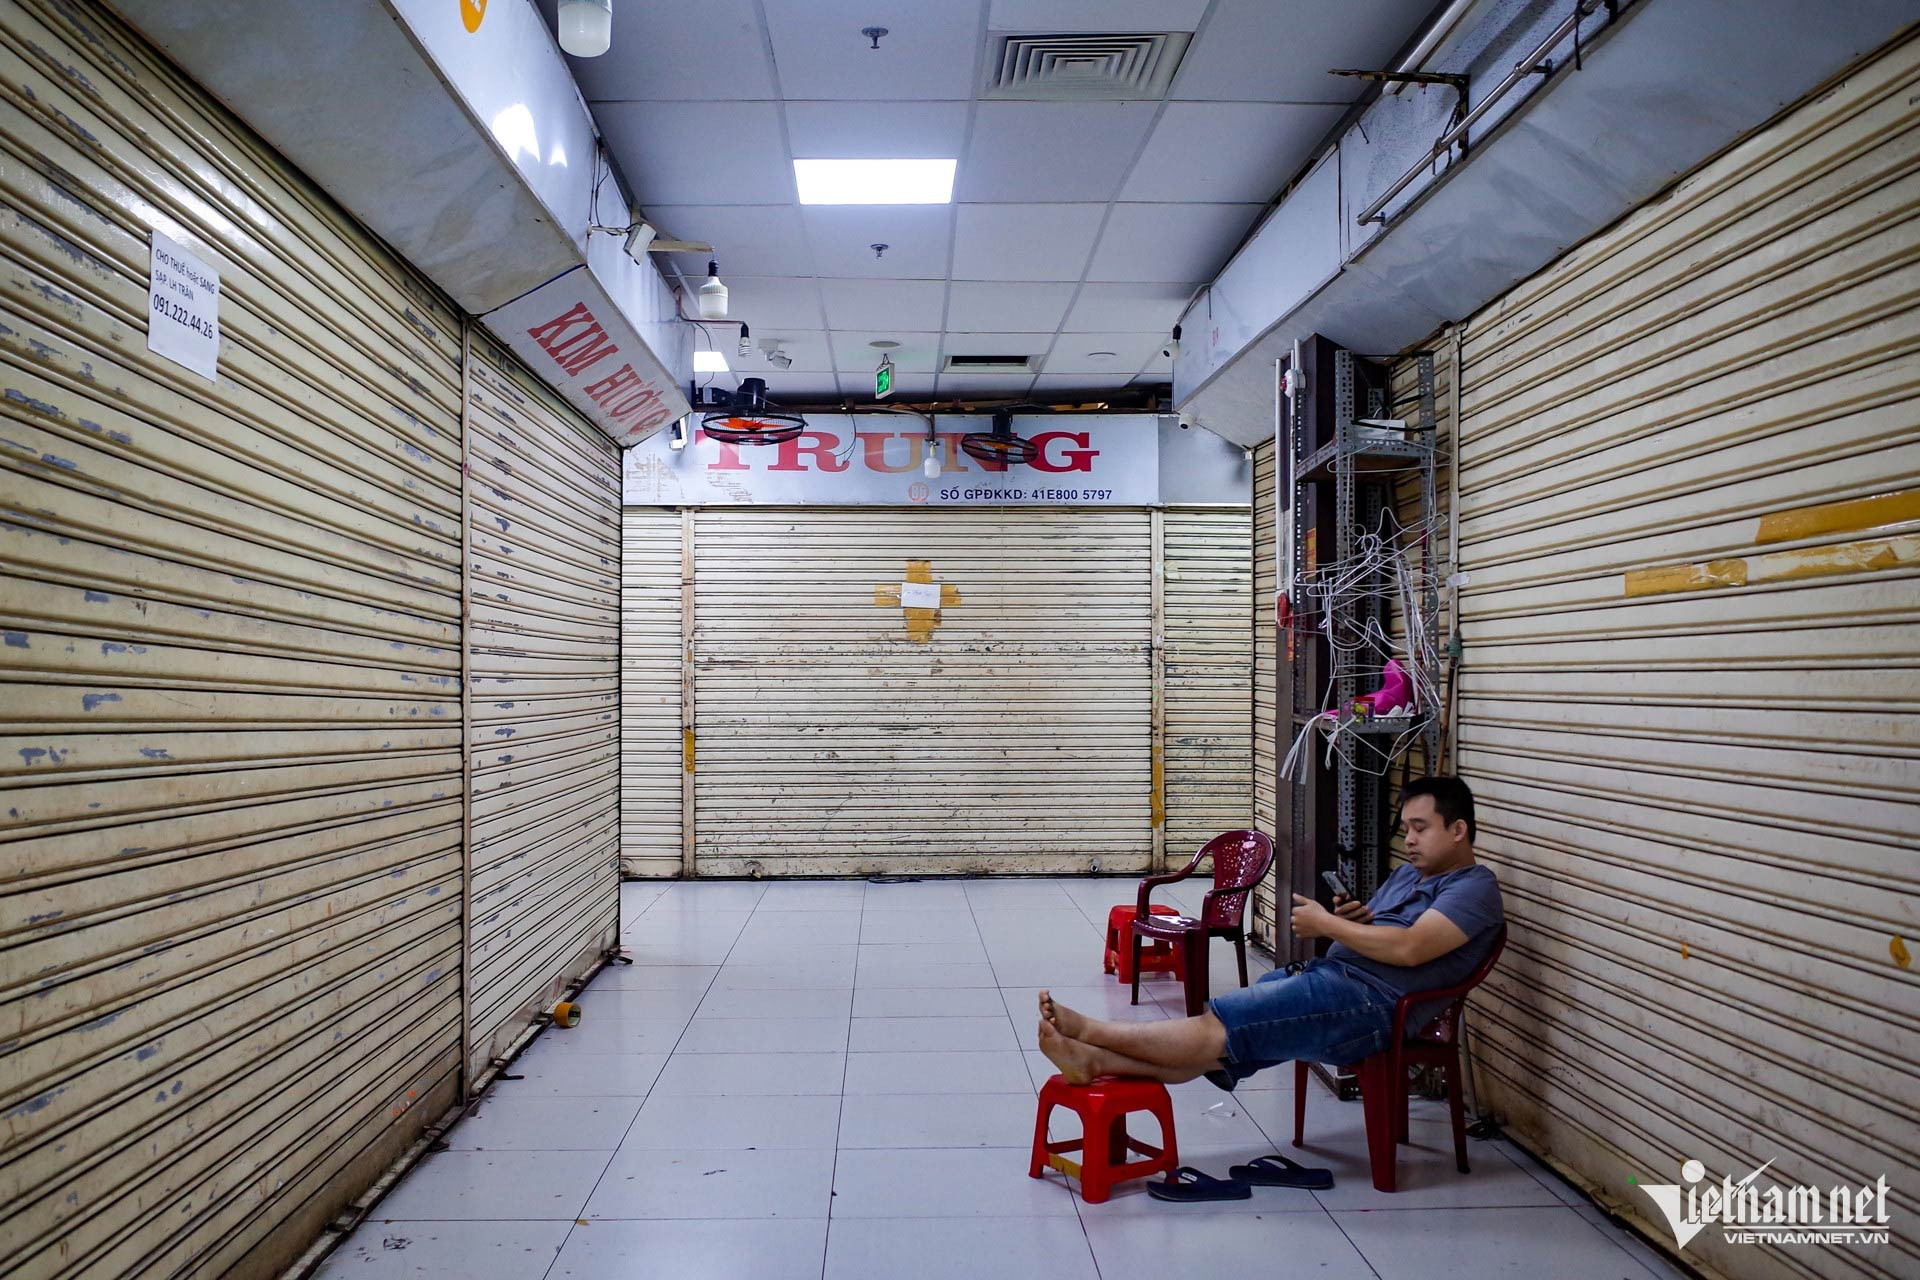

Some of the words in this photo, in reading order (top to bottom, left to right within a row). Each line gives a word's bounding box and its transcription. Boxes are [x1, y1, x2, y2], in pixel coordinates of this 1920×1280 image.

[155, 248, 169, 265] CHO
[199, 276, 215, 294] SANG
[169, 277, 177, 292] LH
[153, 294, 213, 339] 091.222.44.26
[527, 301, 619, 378] KIM
[694, 429, 1100, 473] TRUNG
[940, 485, 960, 500] SỐ
[964, 489, 1028, 500] GPĐKKD:
[1031, 489, 1078, 500] 41E800
[1083, 489, 1112, 500] 5797
